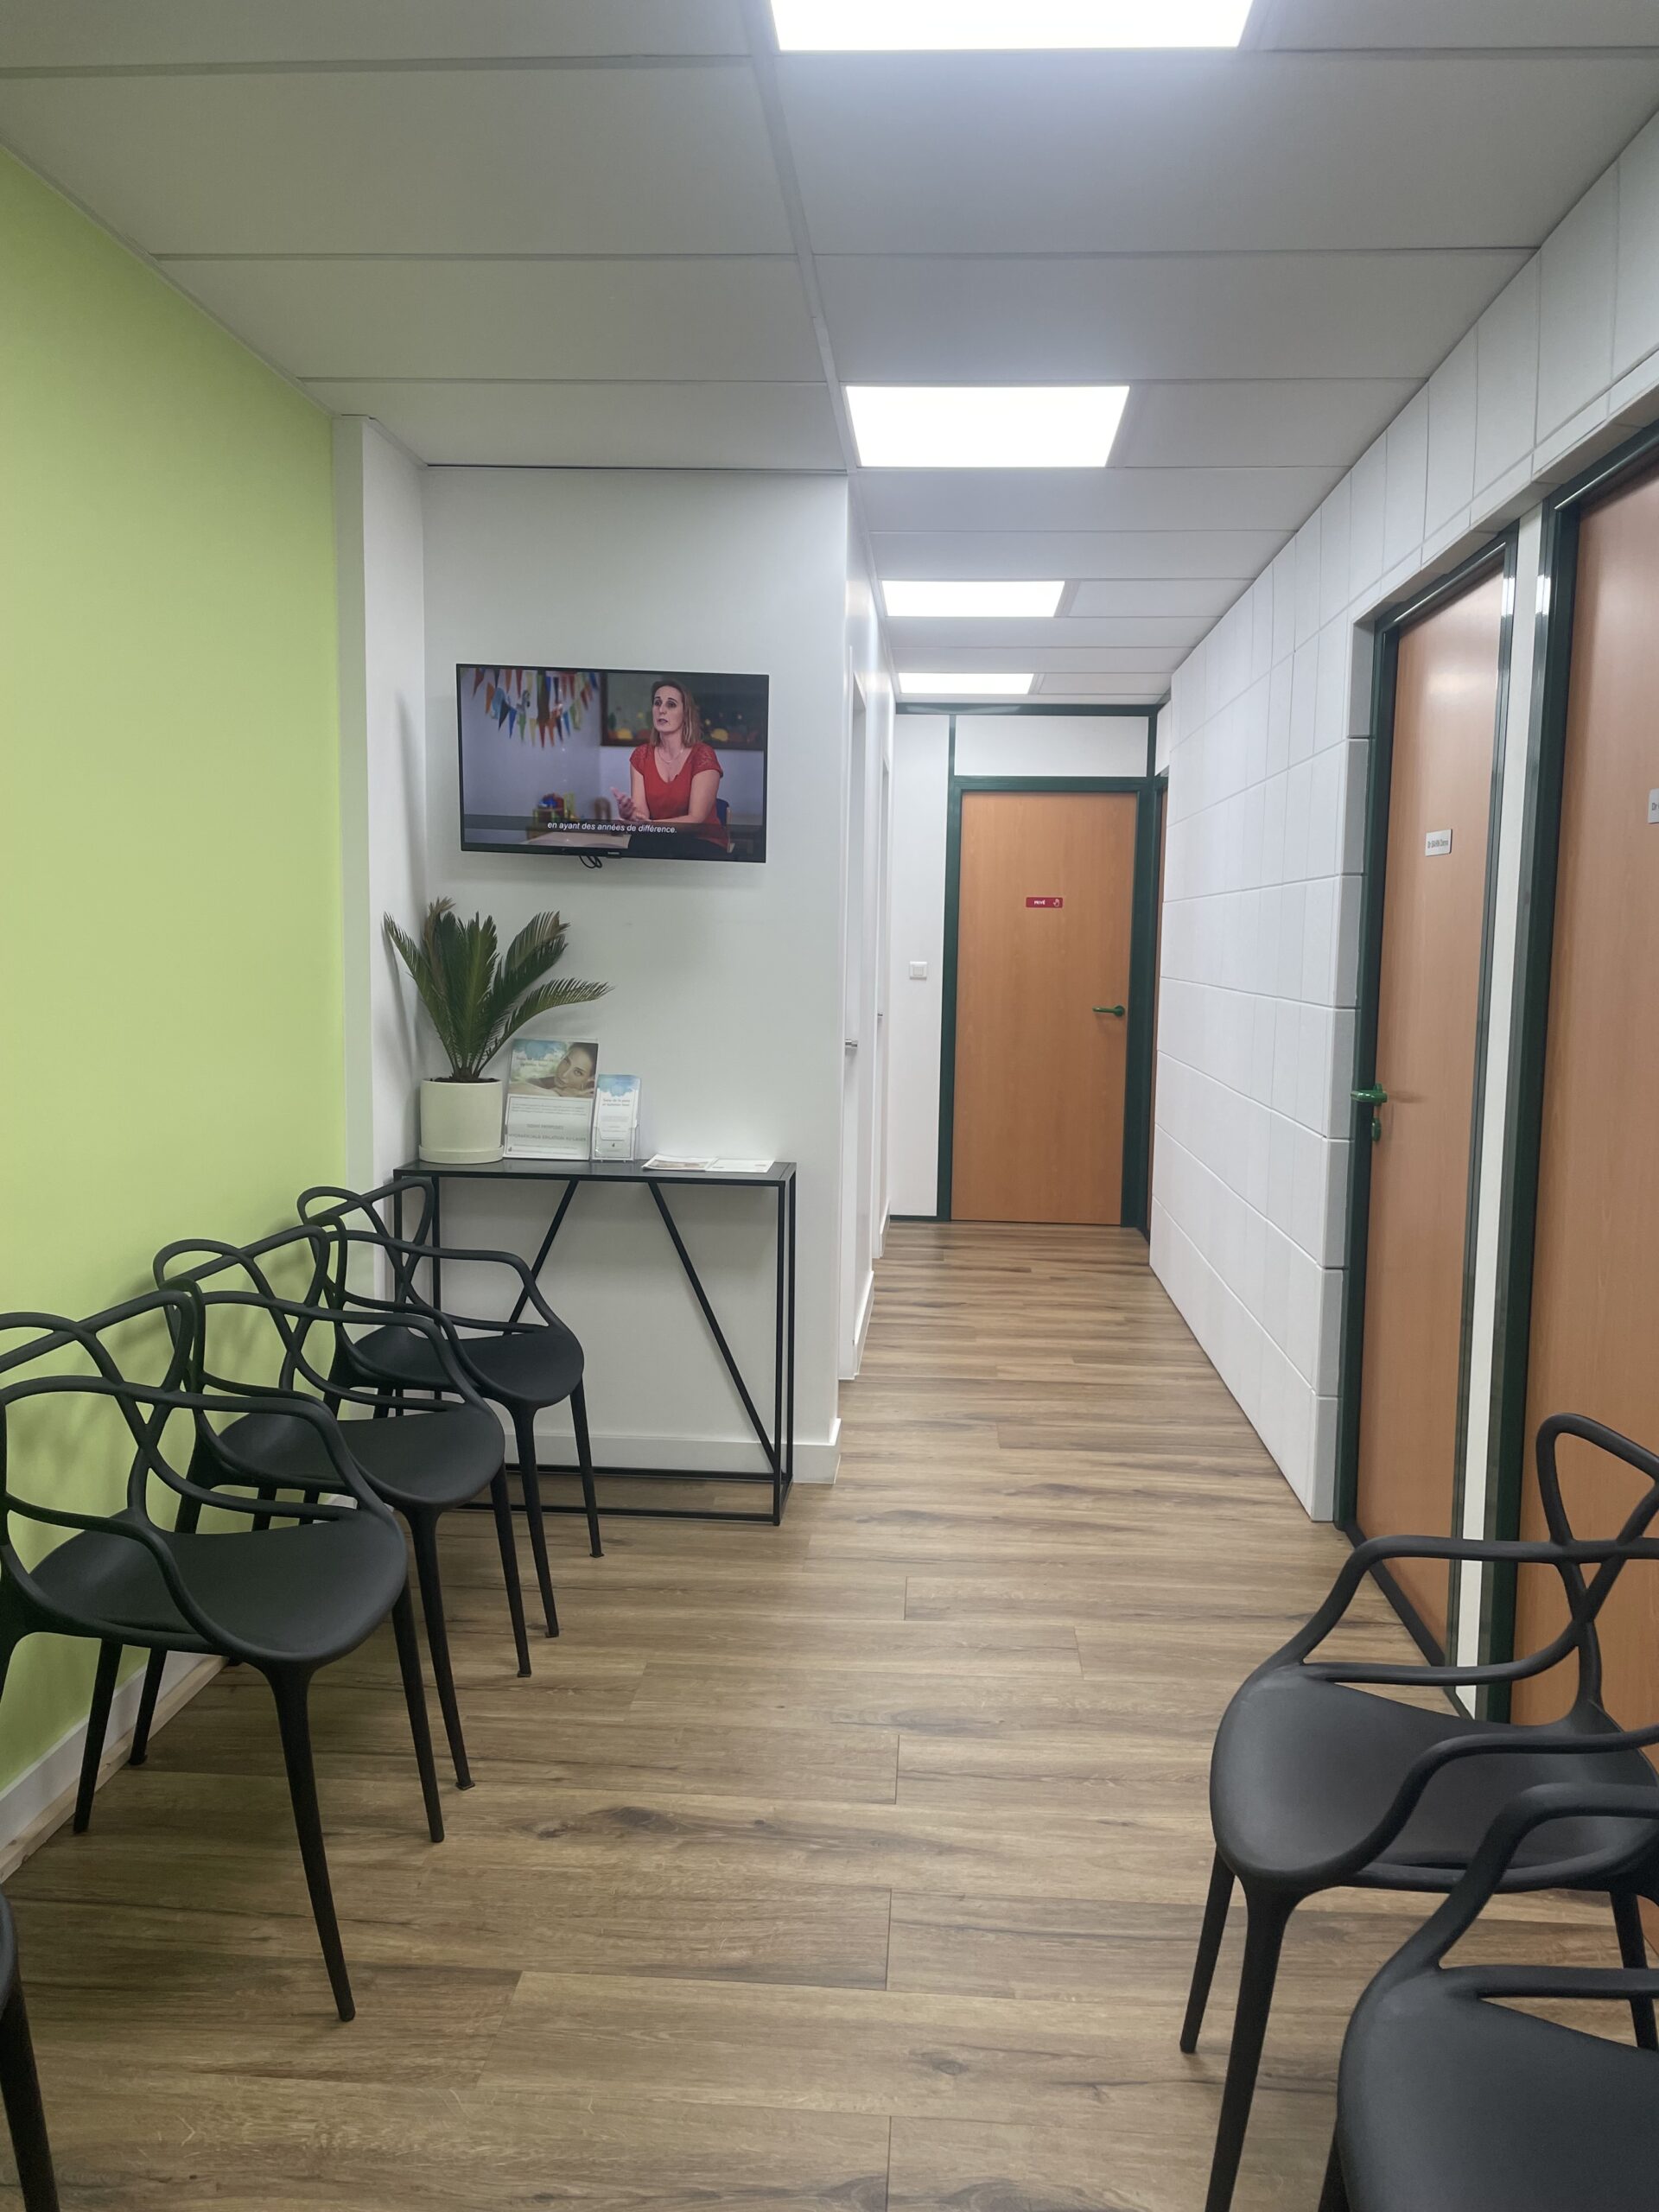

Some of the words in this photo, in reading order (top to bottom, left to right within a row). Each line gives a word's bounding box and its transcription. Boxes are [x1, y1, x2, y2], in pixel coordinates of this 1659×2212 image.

[559, 822, 580, 830] ayant
[597, 823, 625, 831] années
[638, 824, 677, 833] différence.
